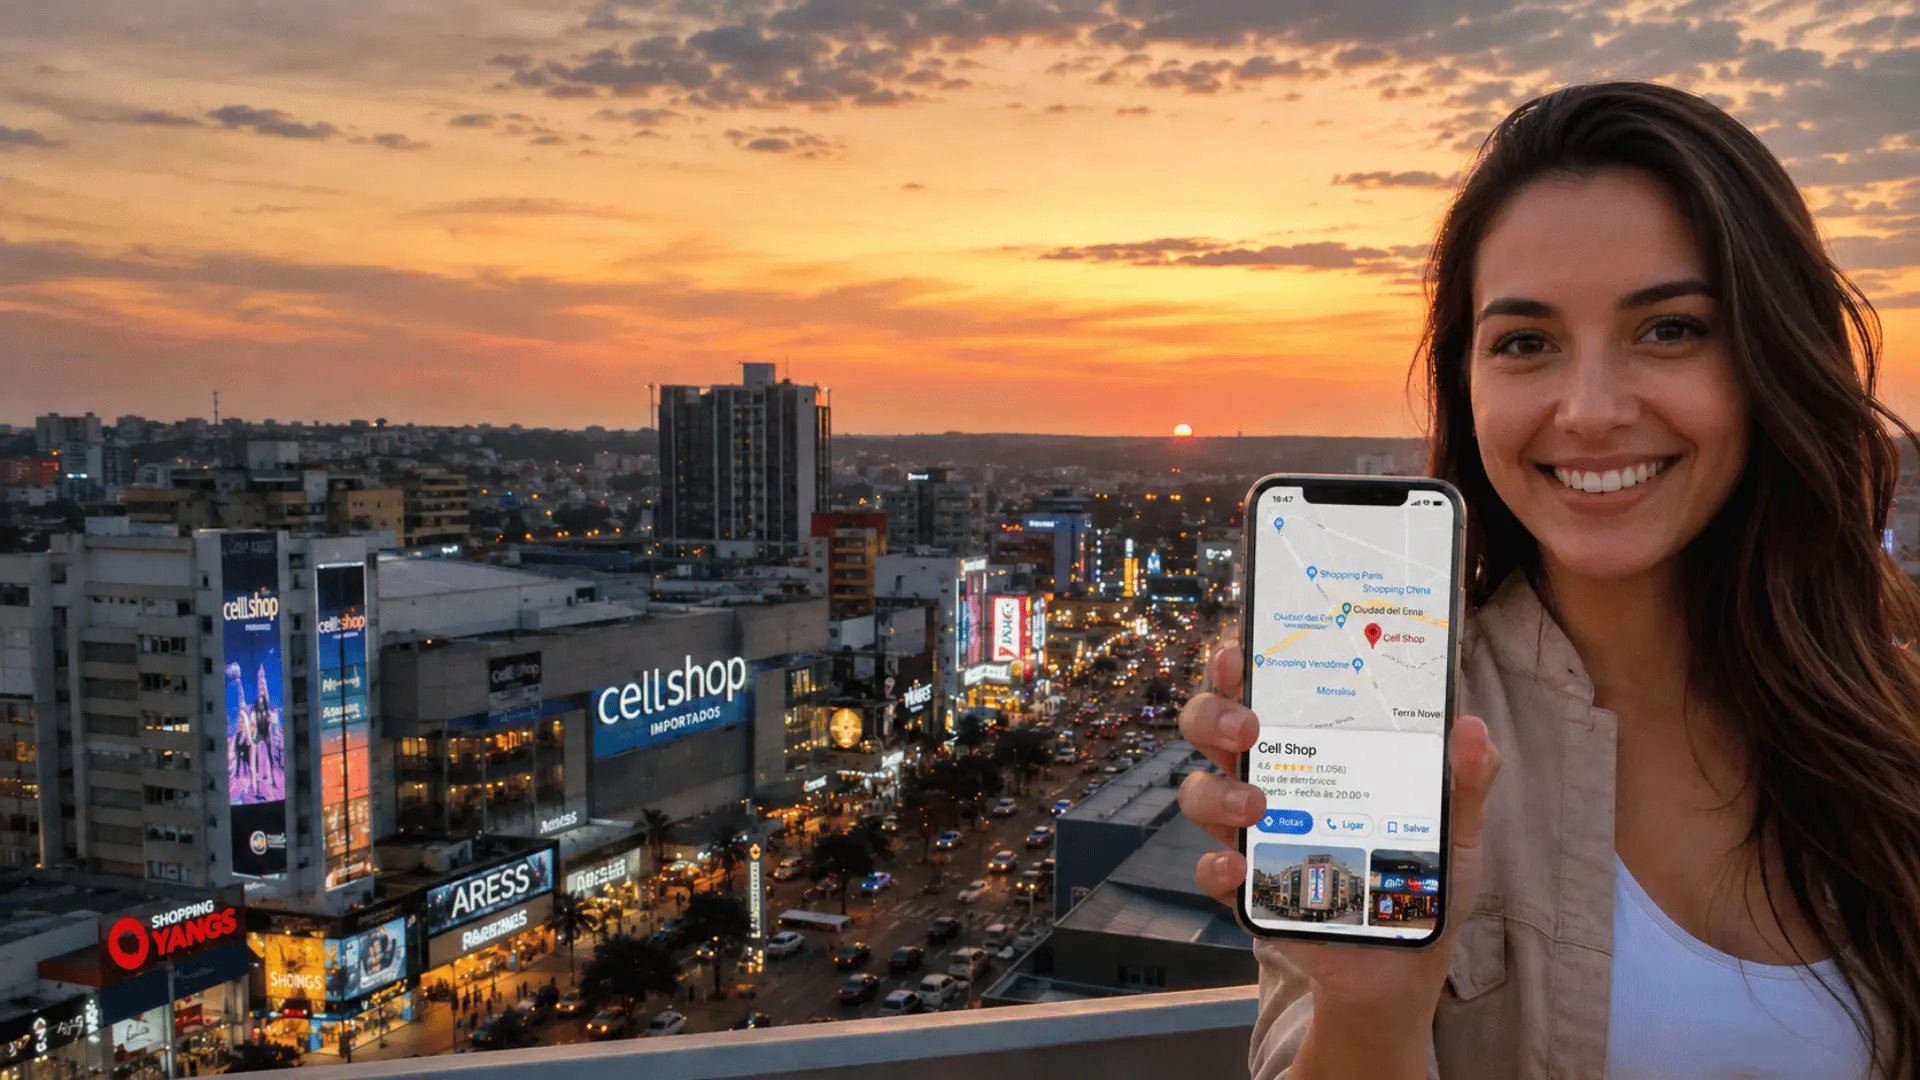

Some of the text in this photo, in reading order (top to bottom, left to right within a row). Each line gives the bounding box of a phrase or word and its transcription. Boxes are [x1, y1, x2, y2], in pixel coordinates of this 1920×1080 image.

[1319, 569, 1360, 580] Shopping
[1362, 584, 1431, 595] Shopping China
[1387, 606, 1401, 615] del
[1402, 634, 1425, 644] Shop
[1392, 708, 1416, 717] Terra
[650, 706, 721, 736] IMPORTADOS
[1258, 741, 1317, 758] Cell Shop
[1276, 775, 1288, 783] de
[1278, 818, 1304, 827] Rotas
[1342, 819, 1365, 830] Ligar
[1403, 824, 1430, 833] Salvar
[451, 863, 530, 919] ARESS
[151, 899, 215, 929] SHOPPING
[151, 907, 237, 956] YANGS
